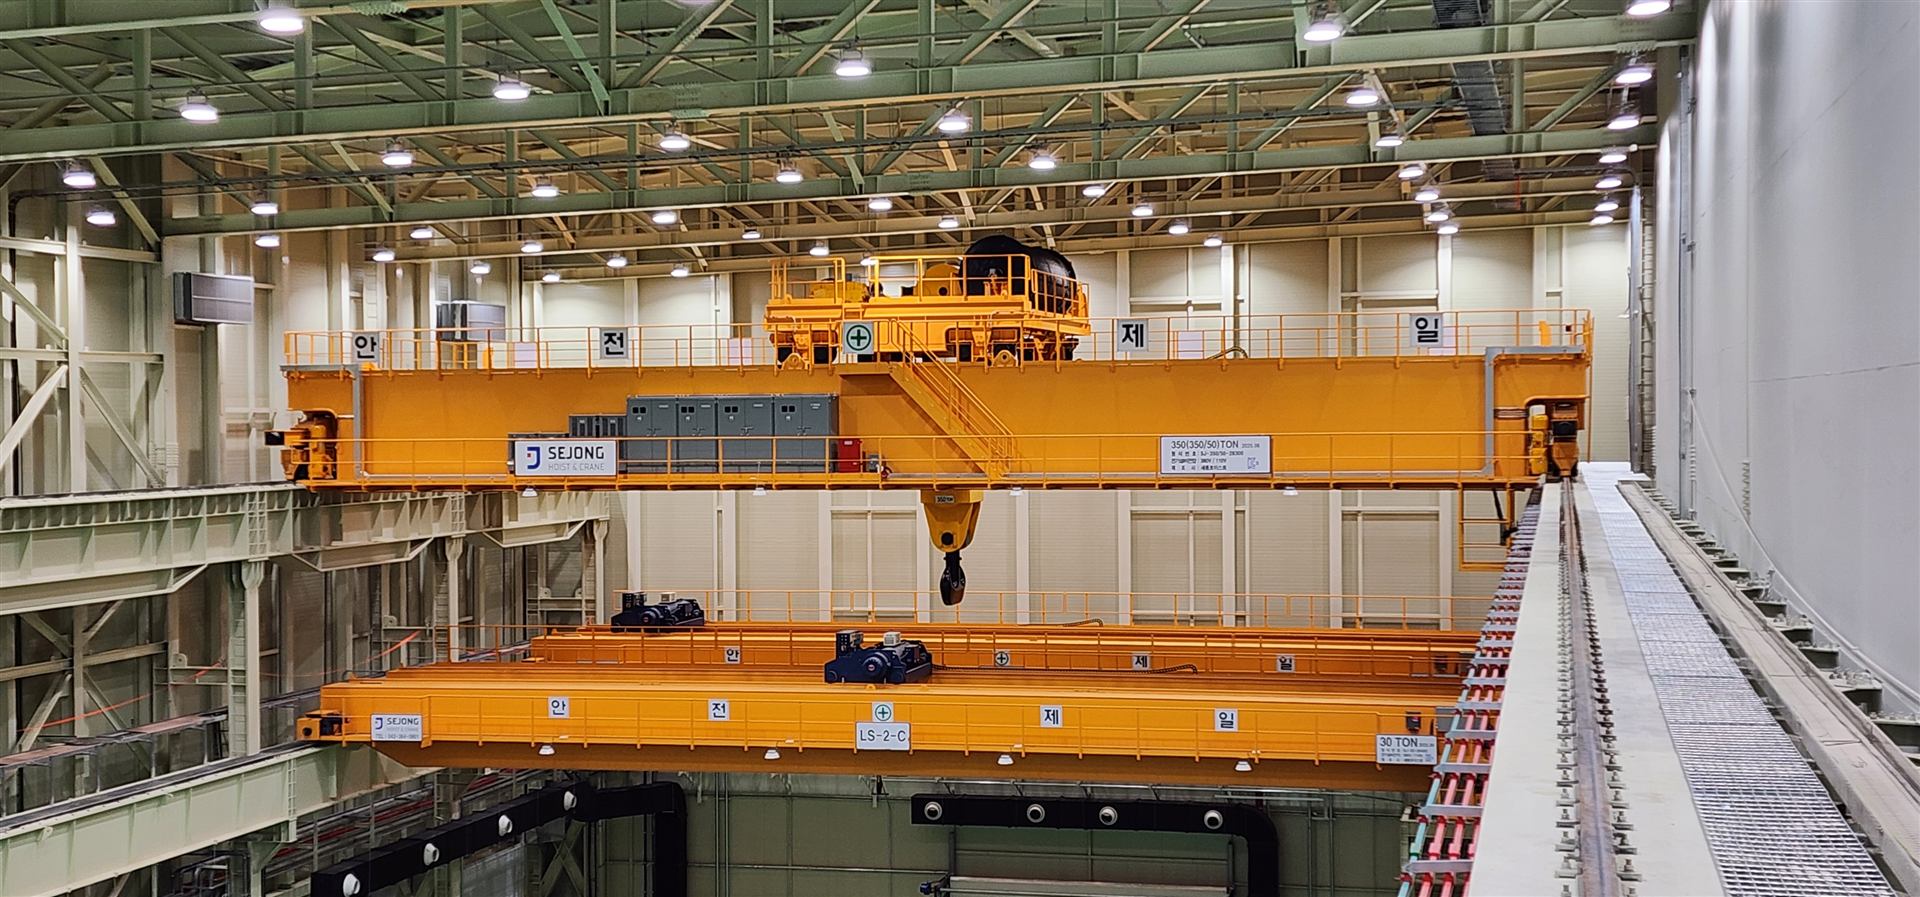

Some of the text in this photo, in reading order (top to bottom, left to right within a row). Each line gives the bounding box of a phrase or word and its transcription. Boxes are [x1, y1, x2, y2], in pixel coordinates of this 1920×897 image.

[1122, 324, 1144, 348] 제
[1415, 317, 1440, 343] 일
[355, 336, 377, 359] 안
[604, 332, 625, 356] 전
[548, 446, 605, 460] SEJONG
[580, 463, 605, 471] CRANE
[726, 648, 740, 662] 안
[1135, 655, 1148, 668] 제
[1278, 656, 1293, 671] 일
[551, 699, 566, 716] 안
[712, 703, 726, 719] 전
[387, 717, 420, 725] SEJONG
[1044, 708, 1059, 725] 제
[1218, 711, 1234, 729] 일
[860, 729, 906, 742] LS-2-C
[1380, 736, 1392, 747] 30
[1394, 737, 1418, 747] TON
